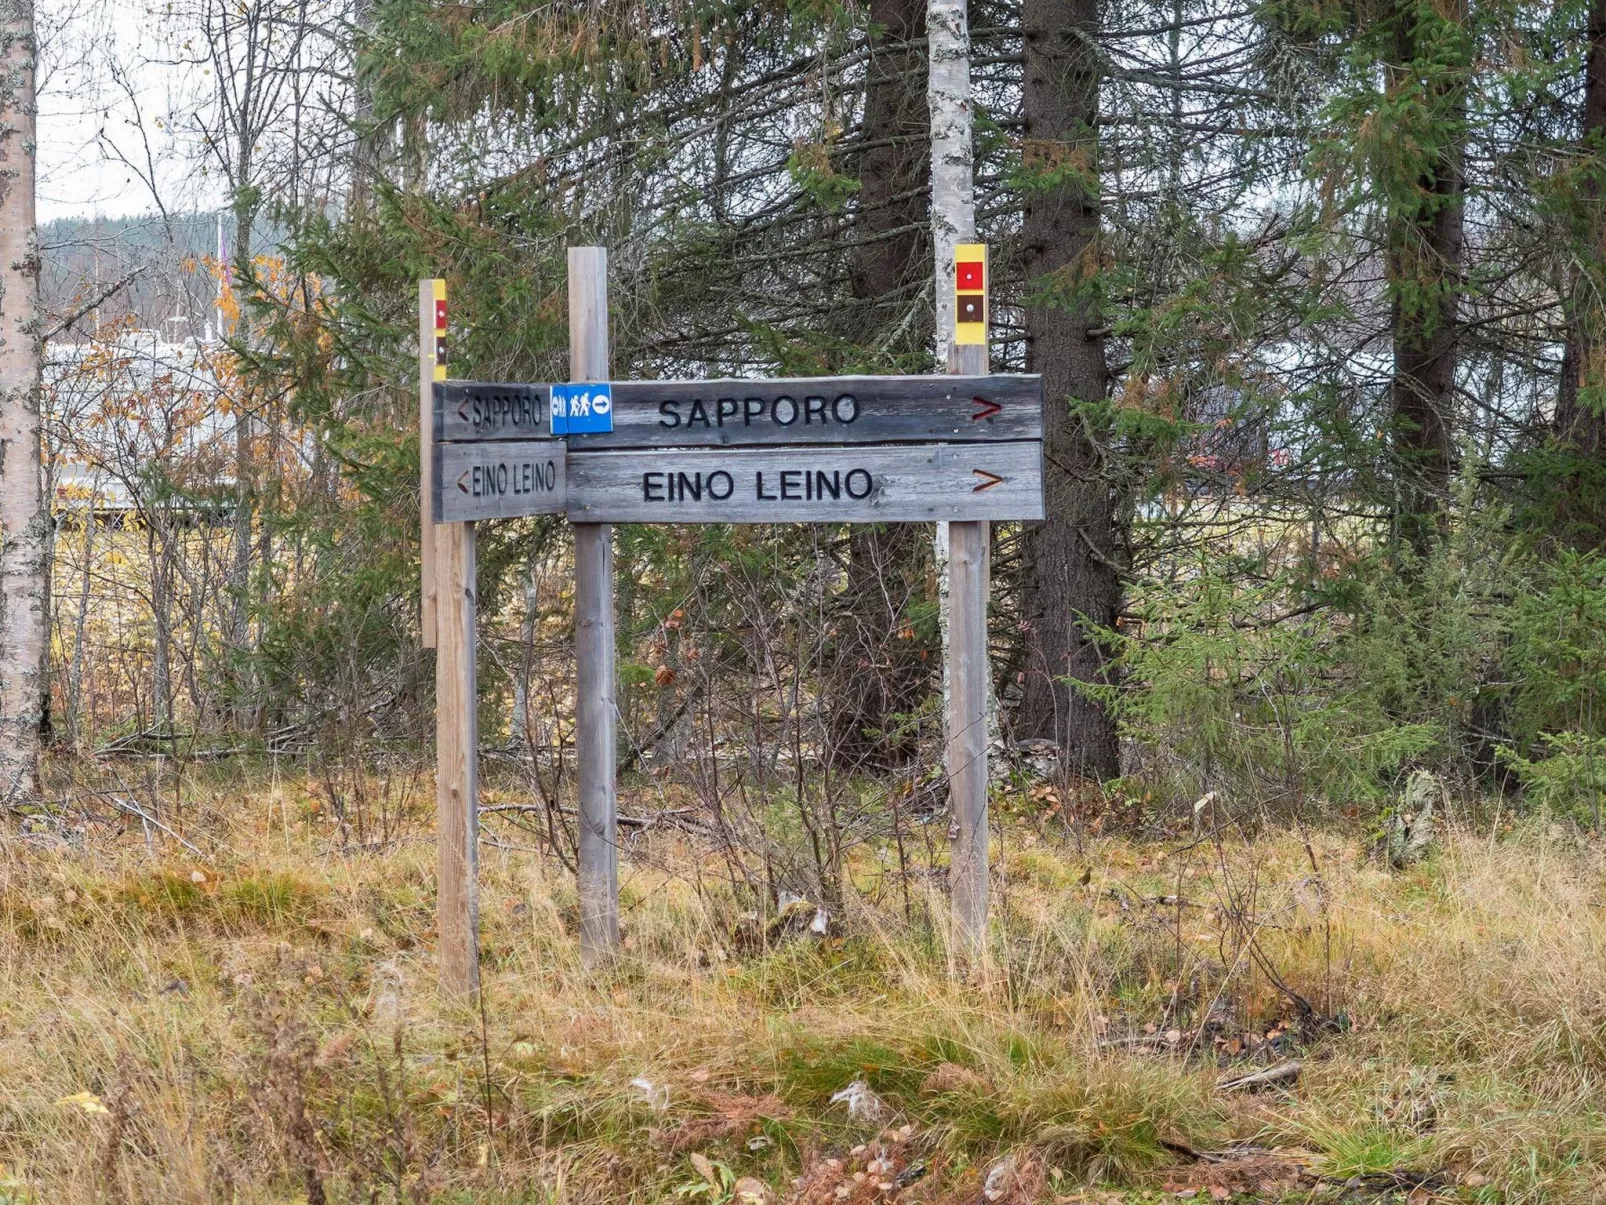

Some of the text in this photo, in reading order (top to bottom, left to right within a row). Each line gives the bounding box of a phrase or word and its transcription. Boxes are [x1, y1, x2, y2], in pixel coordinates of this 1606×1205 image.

[473, 394, 541, 427] SAPPORO
[658, 393, 860, 429] SAPPORO
[472, 460, 556, 497] EINO LEINO
[643, 468, 873, 502] EINO LEINO
